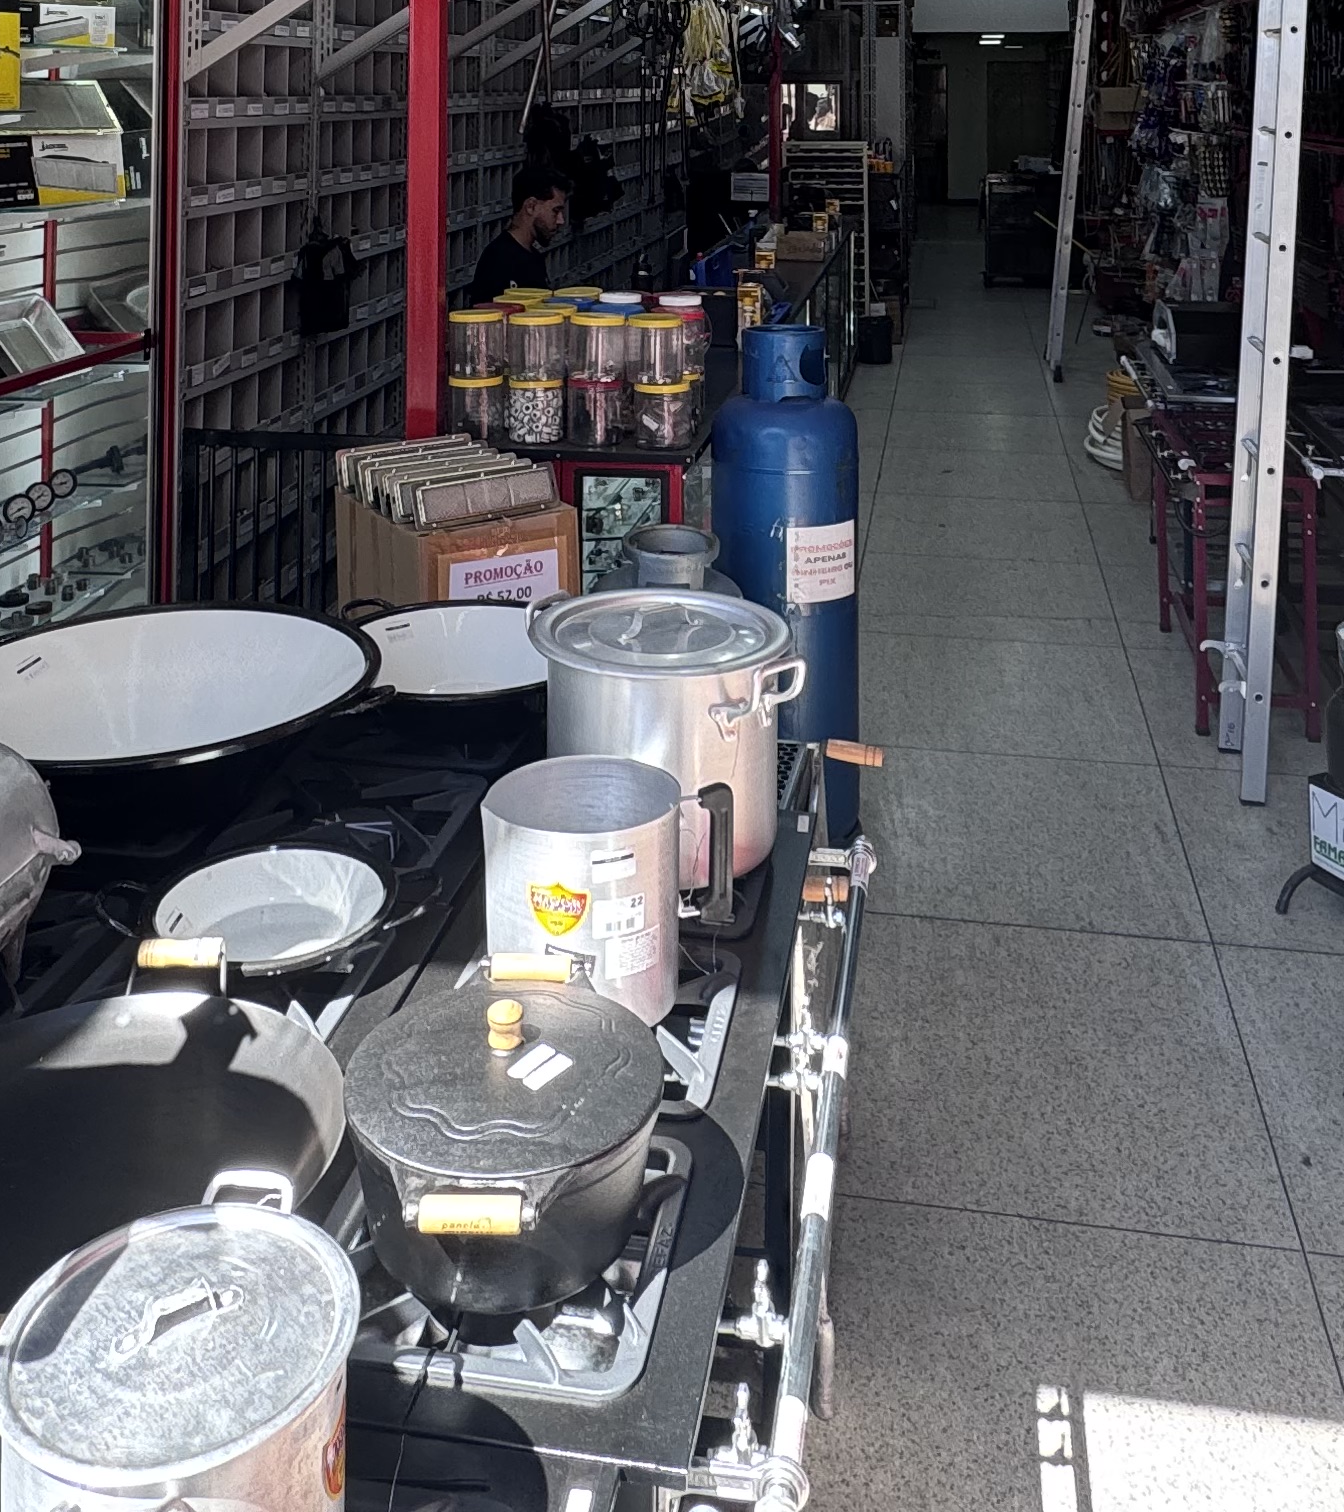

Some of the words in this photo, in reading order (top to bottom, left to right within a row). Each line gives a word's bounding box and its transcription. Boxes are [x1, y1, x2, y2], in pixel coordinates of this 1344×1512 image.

[804, 551, 847, 564] APENAS
[464, 559, 544, 585] PROMOÇÃO
[819, 578, 836, 586] PIX
[631, 895, 644, 909] 22
